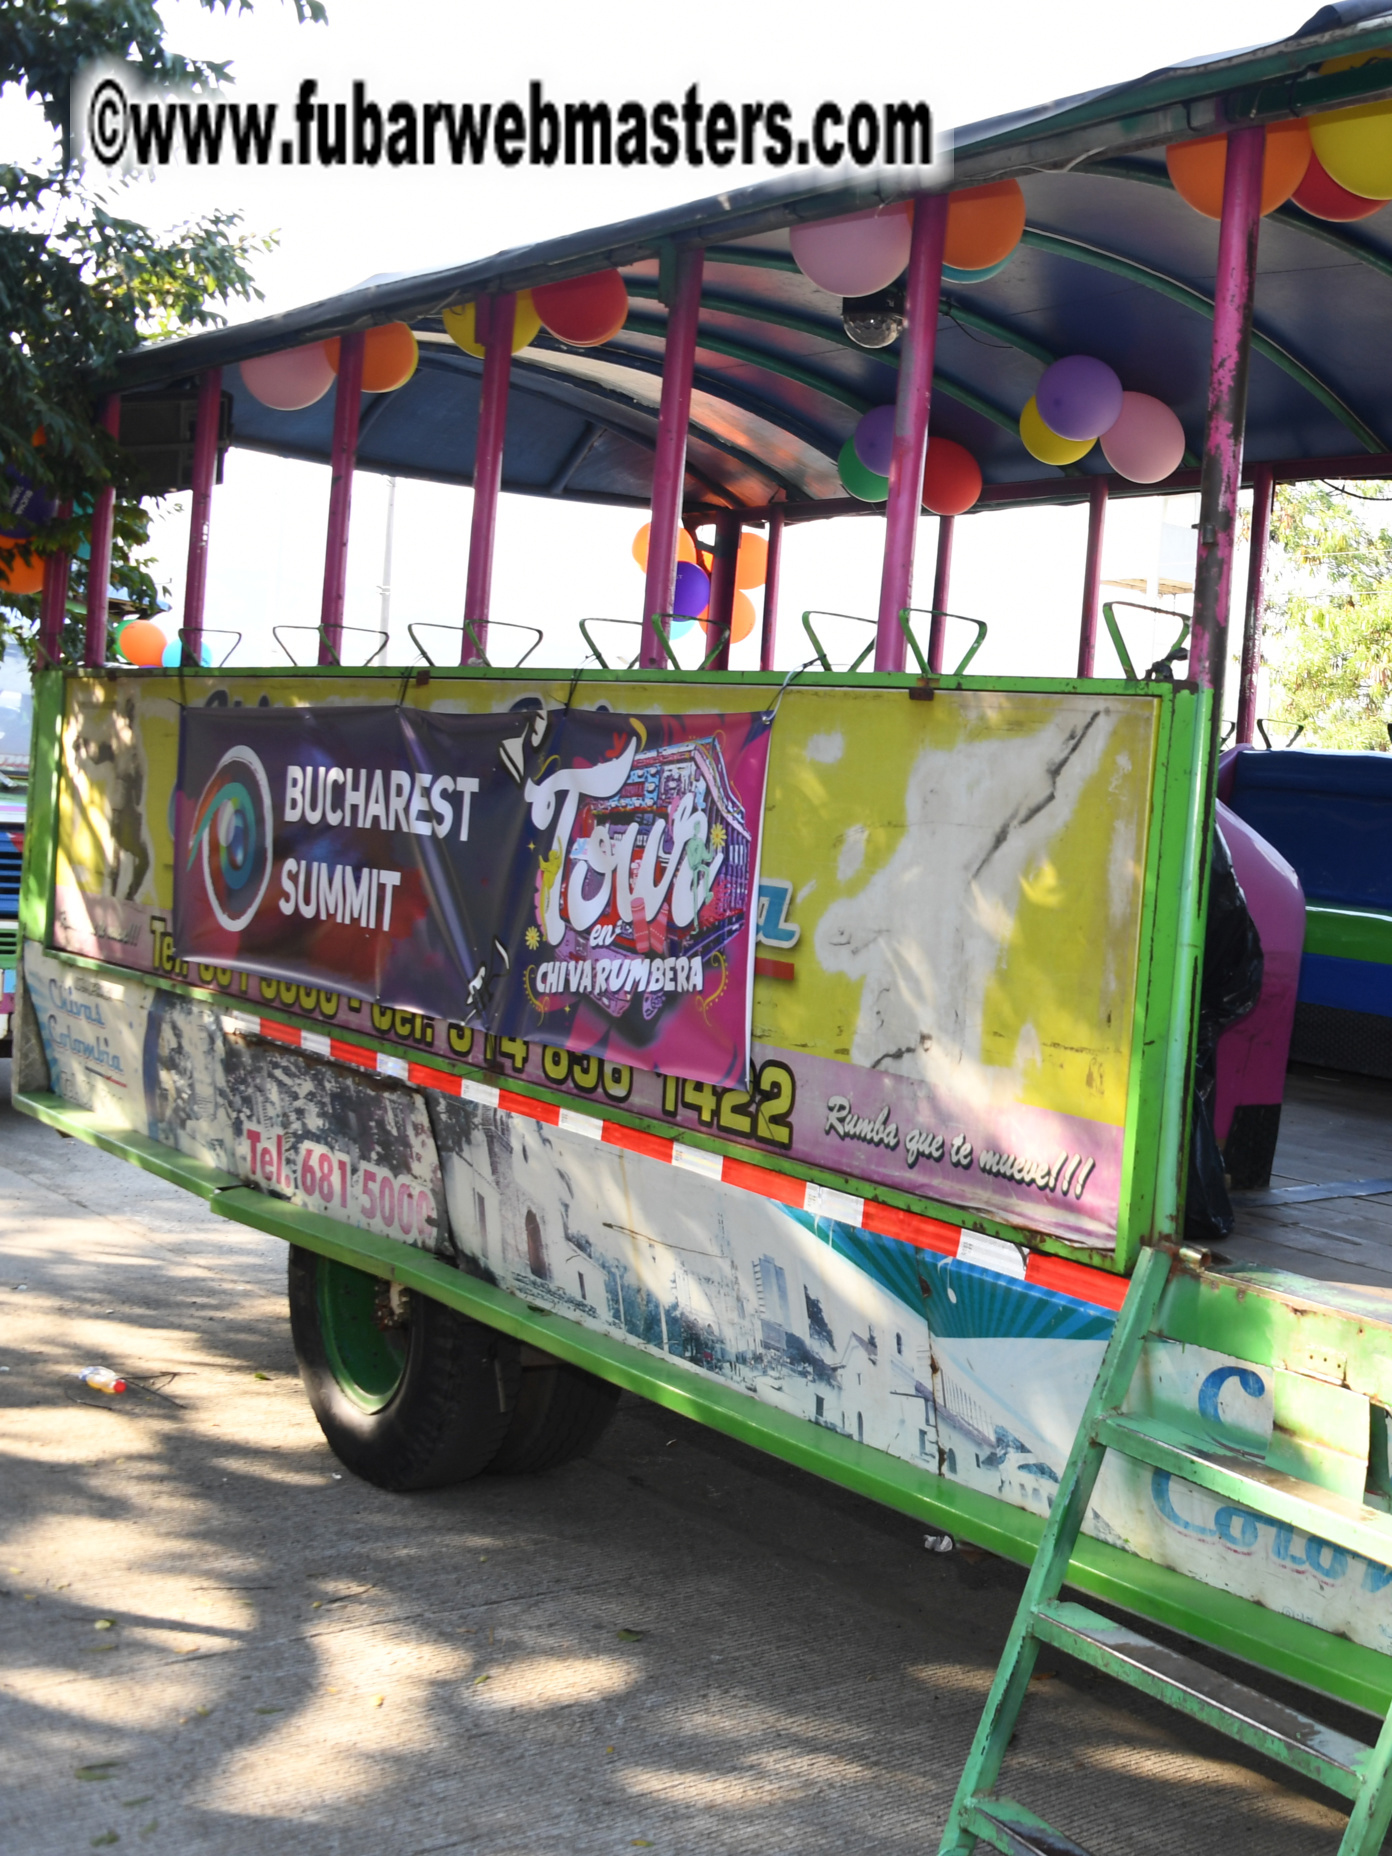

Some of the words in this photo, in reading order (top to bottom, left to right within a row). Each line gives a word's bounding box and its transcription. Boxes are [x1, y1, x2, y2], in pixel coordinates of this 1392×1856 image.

[284, 765, 480, 842] BUCHAREST
[524, 737, 724, 946] Tour
[278, 857, 401, 932] SUMMIT
[589, 922, 618, 947] en
[536, 958, 593, 993] CHIVA
[592, 955, 703, 993] RUMBERA
[246, 1128, 292, 1189] Tel.
[301, 1148, 348, 1209] 681
[824, 1095, 900, 1151] Rumba
[905, 1127, 944, 1169] que
[950, 1132, 973, 1170] te
[979, 1150, 1096, 1199] mueve!!!
